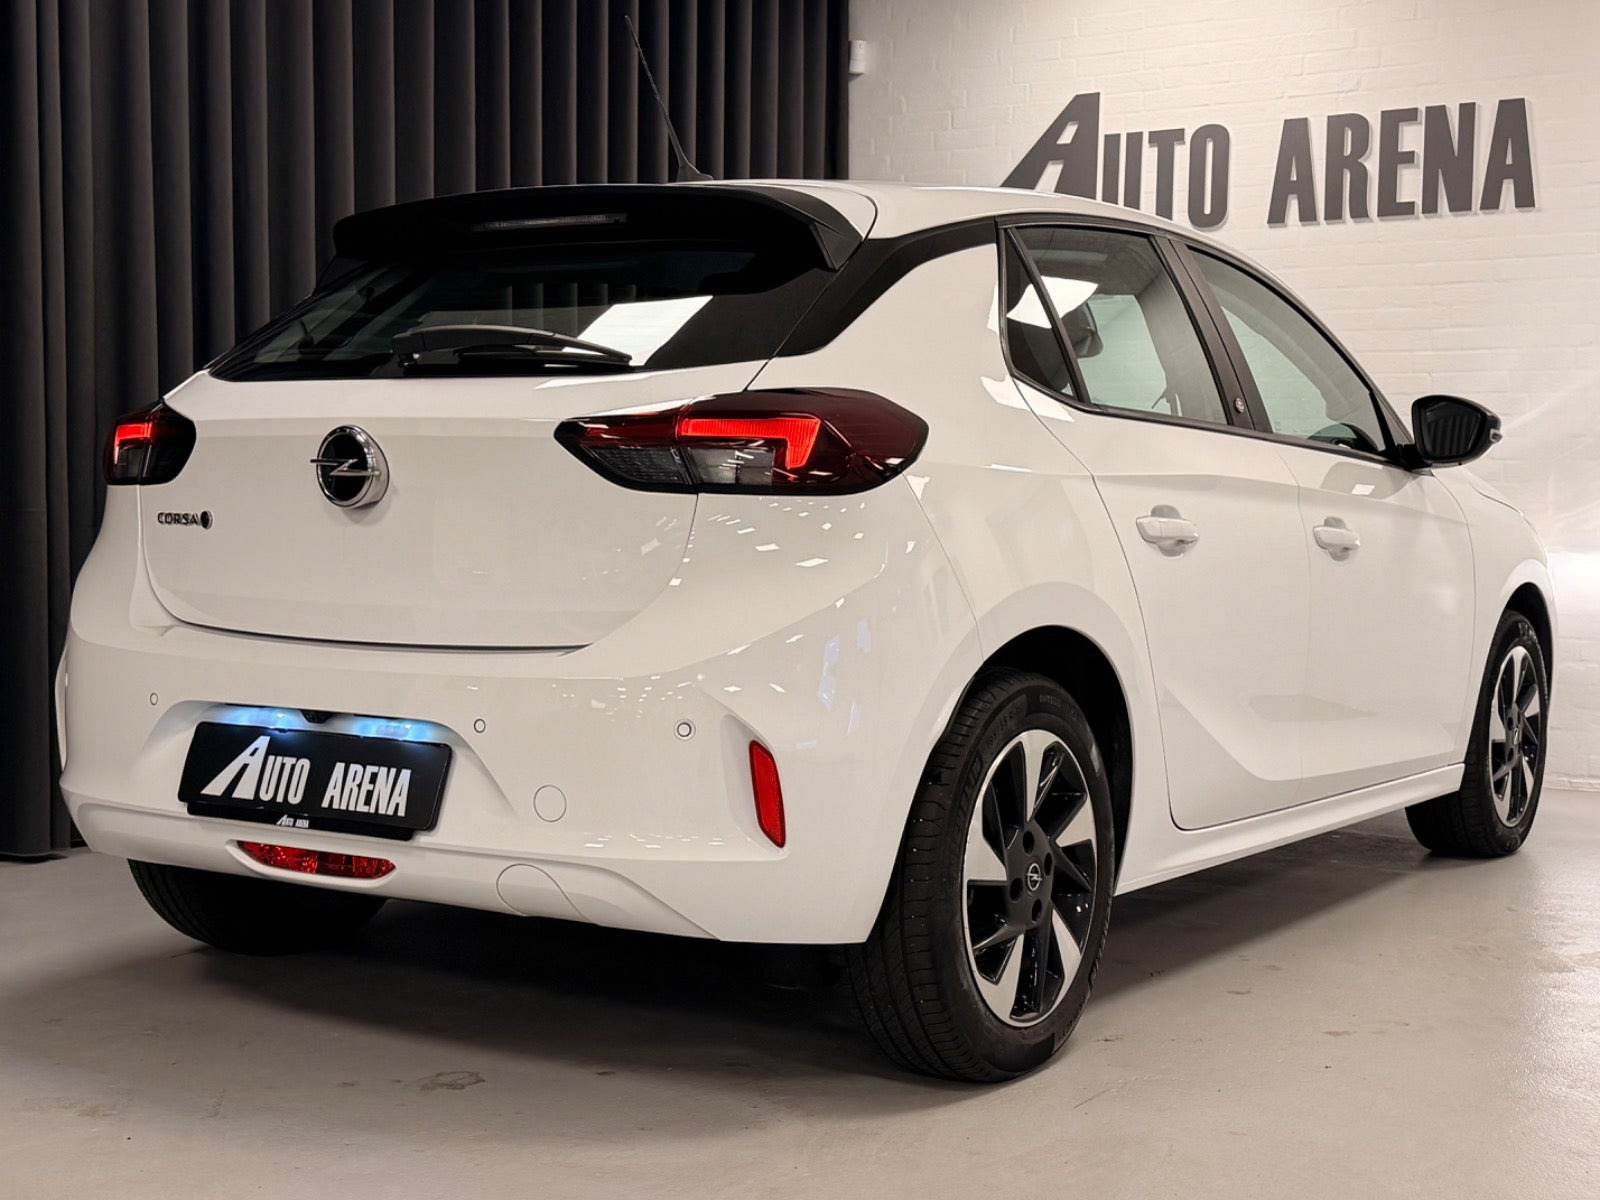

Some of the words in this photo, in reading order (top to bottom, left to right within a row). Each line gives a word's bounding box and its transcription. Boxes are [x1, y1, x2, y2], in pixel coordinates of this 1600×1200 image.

[1000, 92, 1231, 229] AUTO
[1267, 97, 1536, 226] ARENA
[157, 511, 200, 526] CORSA
[200, 735, 311, 806] AUTO
[321, 762, 412, 817] ARENA
